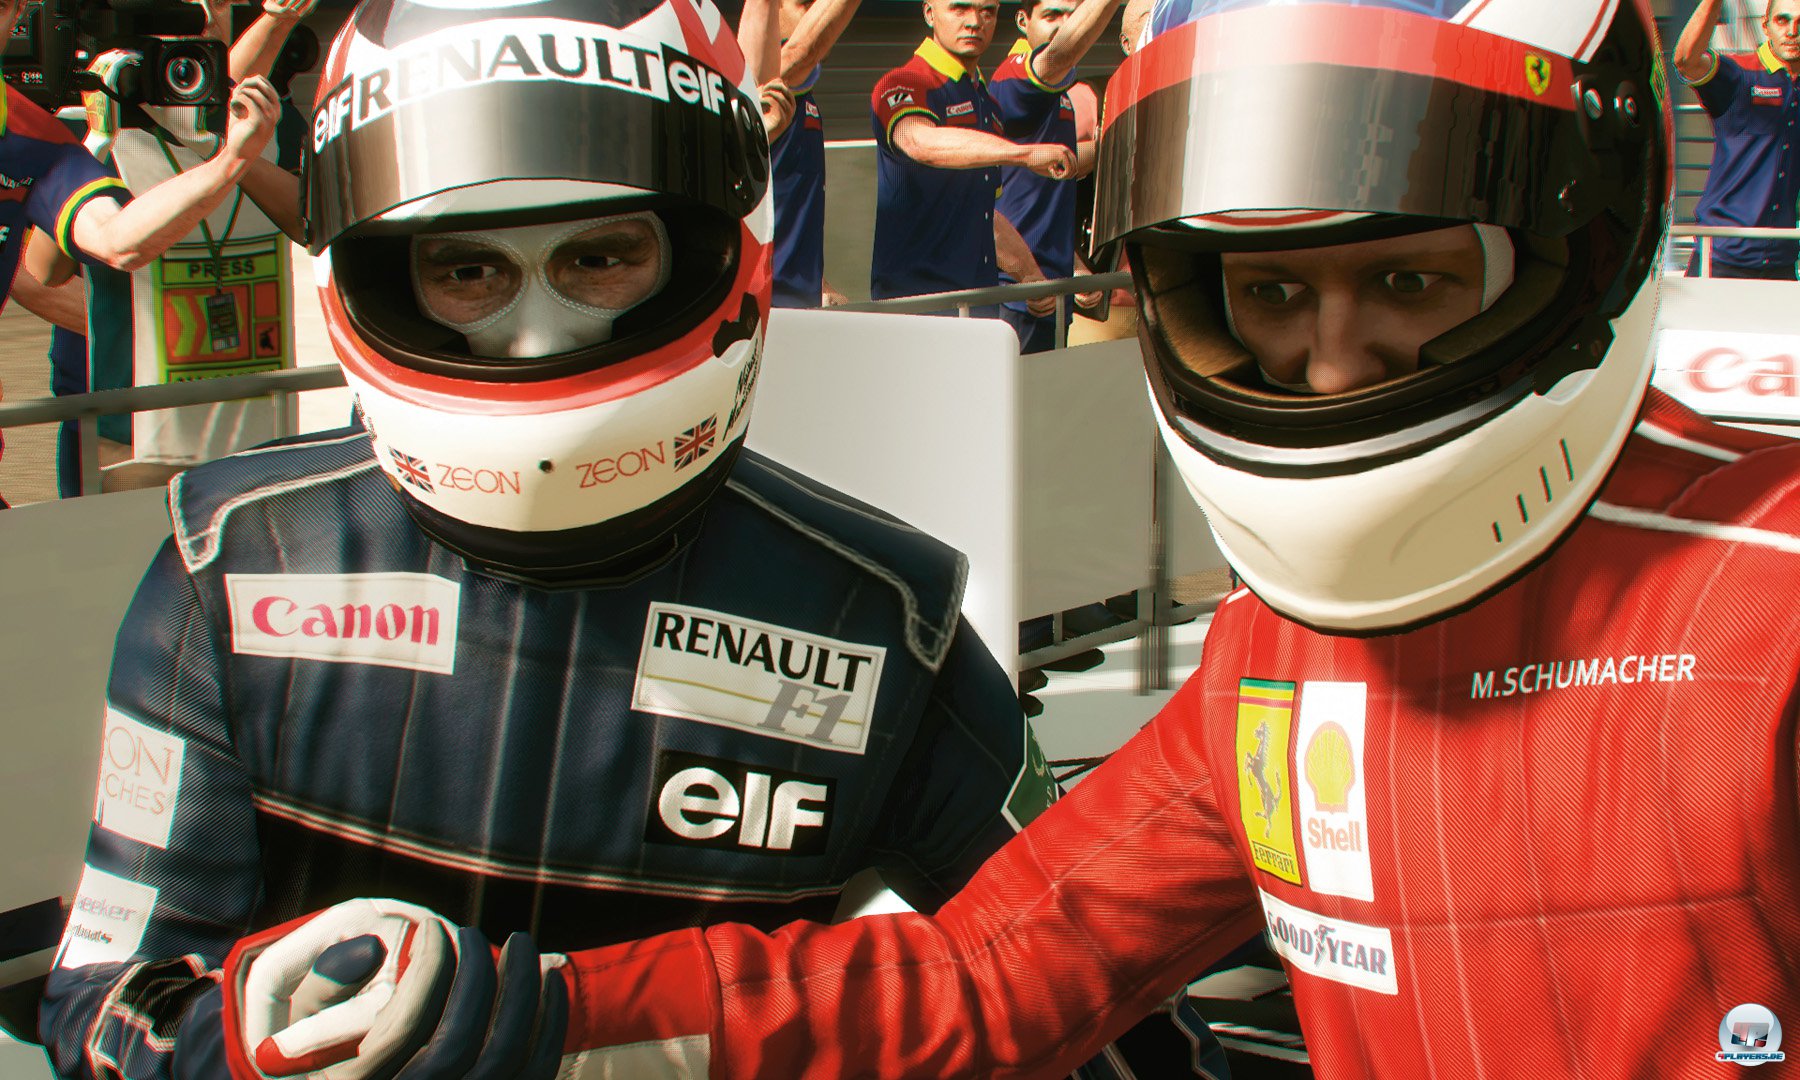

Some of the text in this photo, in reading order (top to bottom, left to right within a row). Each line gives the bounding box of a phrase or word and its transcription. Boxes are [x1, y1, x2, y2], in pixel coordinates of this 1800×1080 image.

[359, 34, 660, 121] RENAULT
[668, 60, 726, 116] elf
[187, 259, 256, 279] PRESS
[436, 463, 521, 494] ZEON
[576, 441, 666, 489] ZEON
[252, 596, 440, 646] Canon
[653, 612, 872, 693] RENAULT
[1470, 653, 1697, 699] M.SCHUMACHER
[756, 679, 852, 743] F1
[105, 726, 175, 785] ON
[103, 772, 166, 815] CHES
[658, 766, 828, 851] elf
[1307, 816, 1363, 852] Shell
